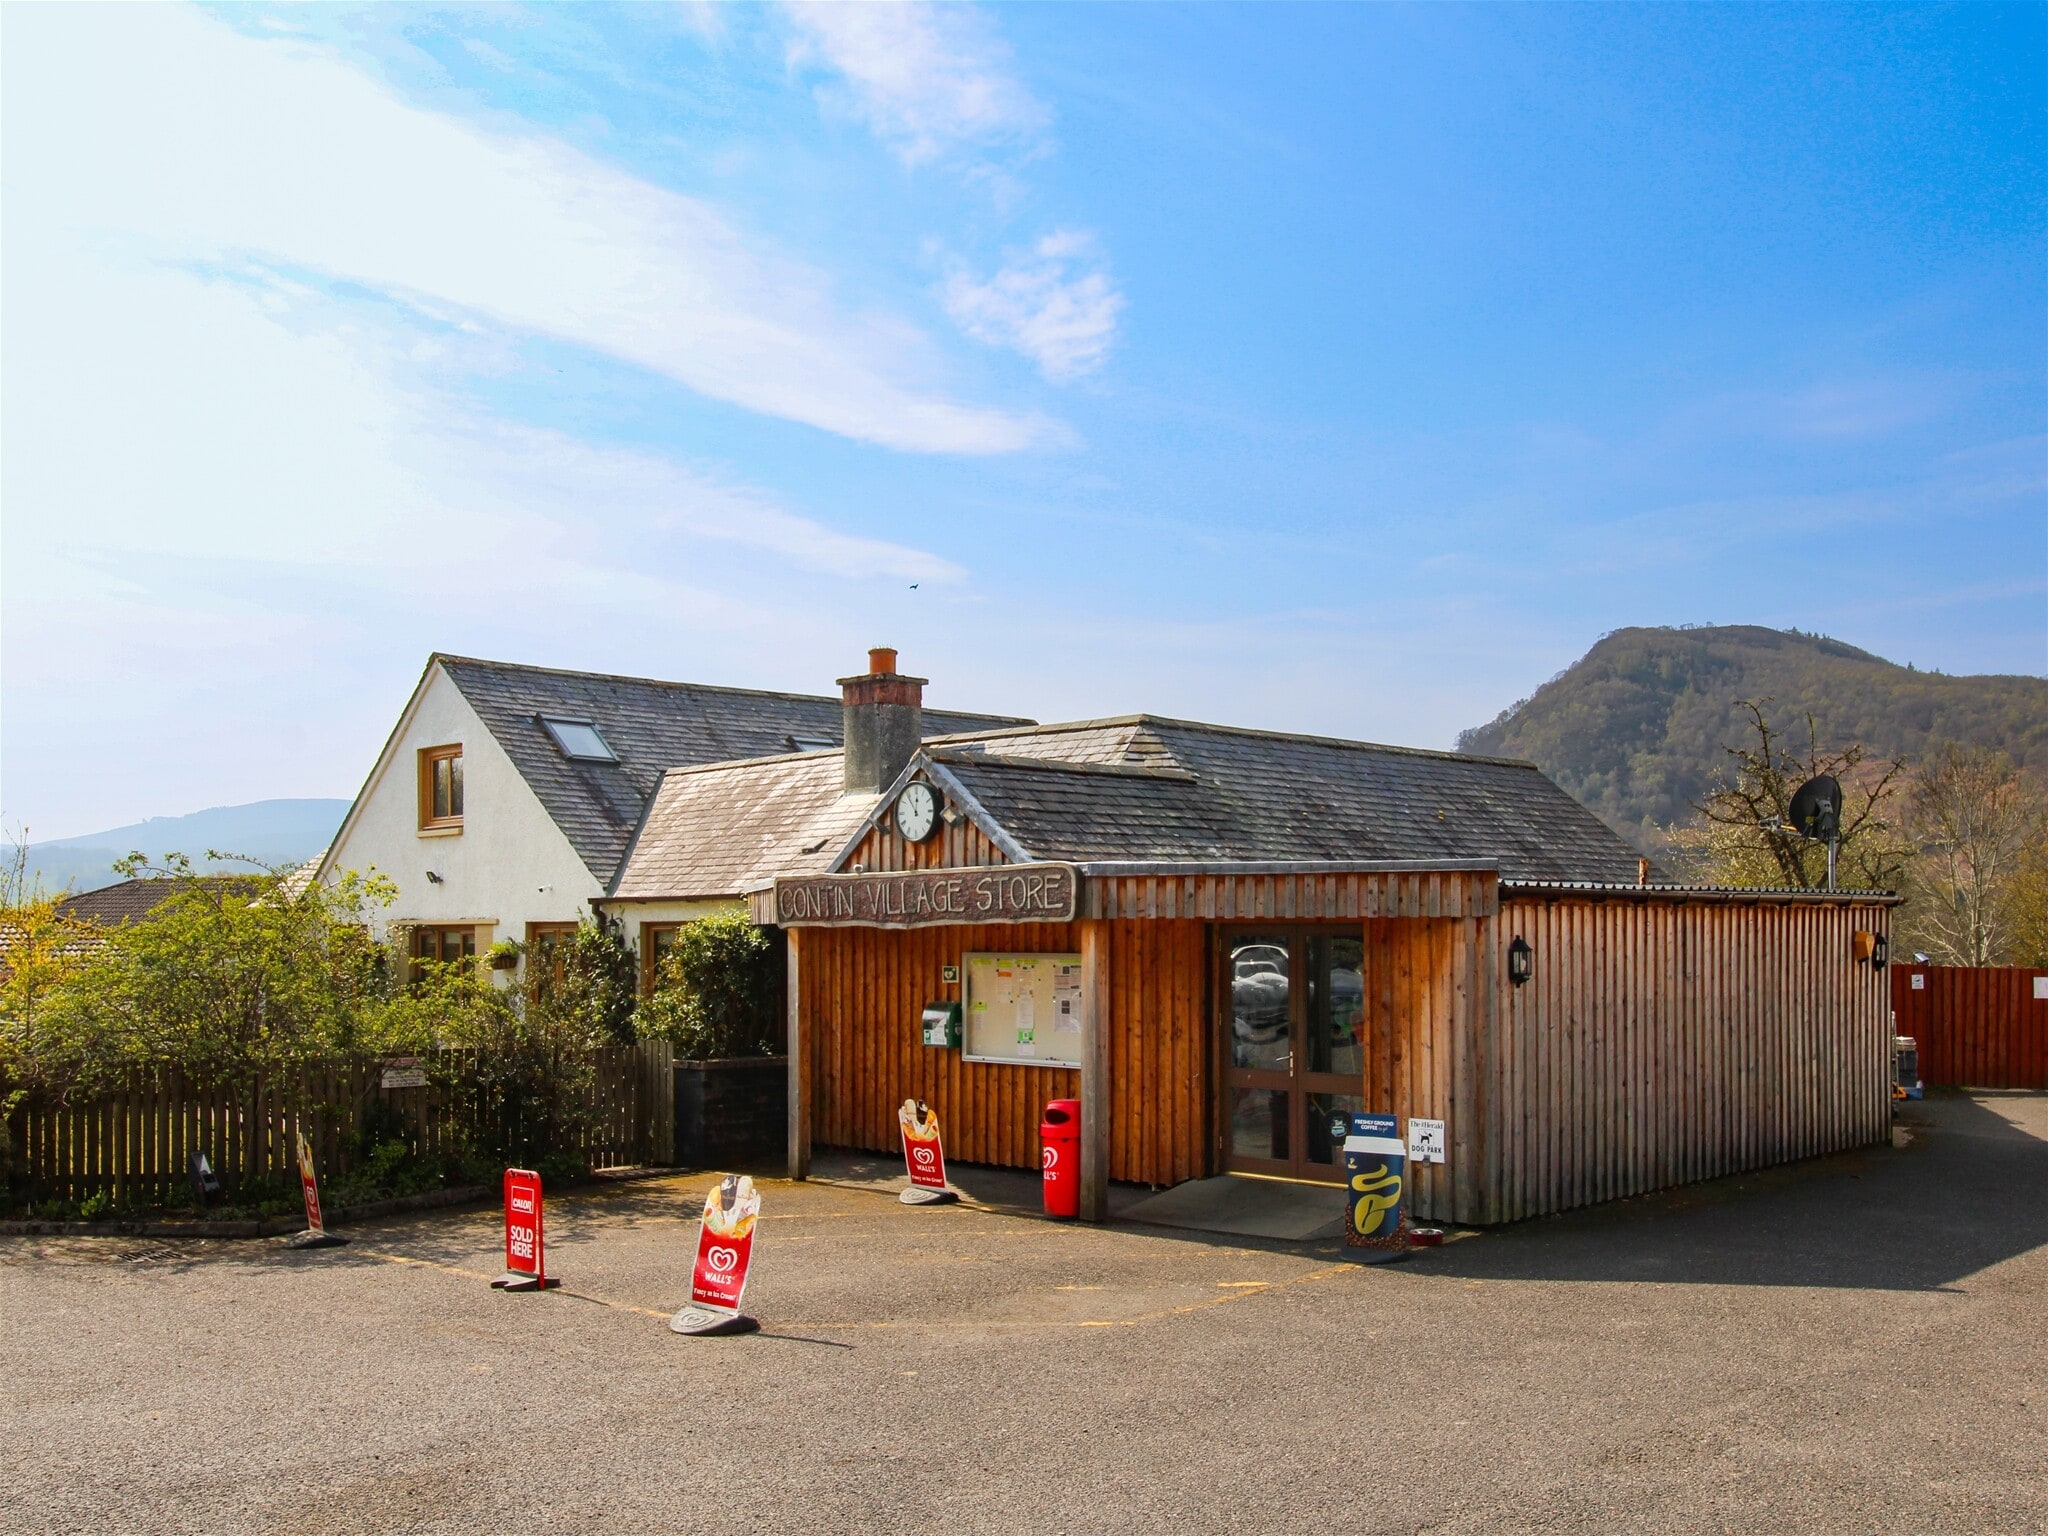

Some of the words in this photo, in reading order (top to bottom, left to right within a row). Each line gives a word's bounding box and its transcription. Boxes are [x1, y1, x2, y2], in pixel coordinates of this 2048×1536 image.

[780, 885, 854, 918] CONTIN
[867, 880, 965, 915] VILLAGE
[976, 874, 1064, 911] STORE
[1424, 1121, 1443, 1130] Herald
[1411, 1145, 1425, 1153] DOG
[1427, 1146, 1442, 1154] PARK
[916, 1164, 936, 1173] WALL'S
[512, 1198, 532, 1212] CALOR
[510, 1225, 534, 1243] SOLD
[510, 1239, 533, 1259] HERE
[705, 1271, 732, 1285] WALL'S
